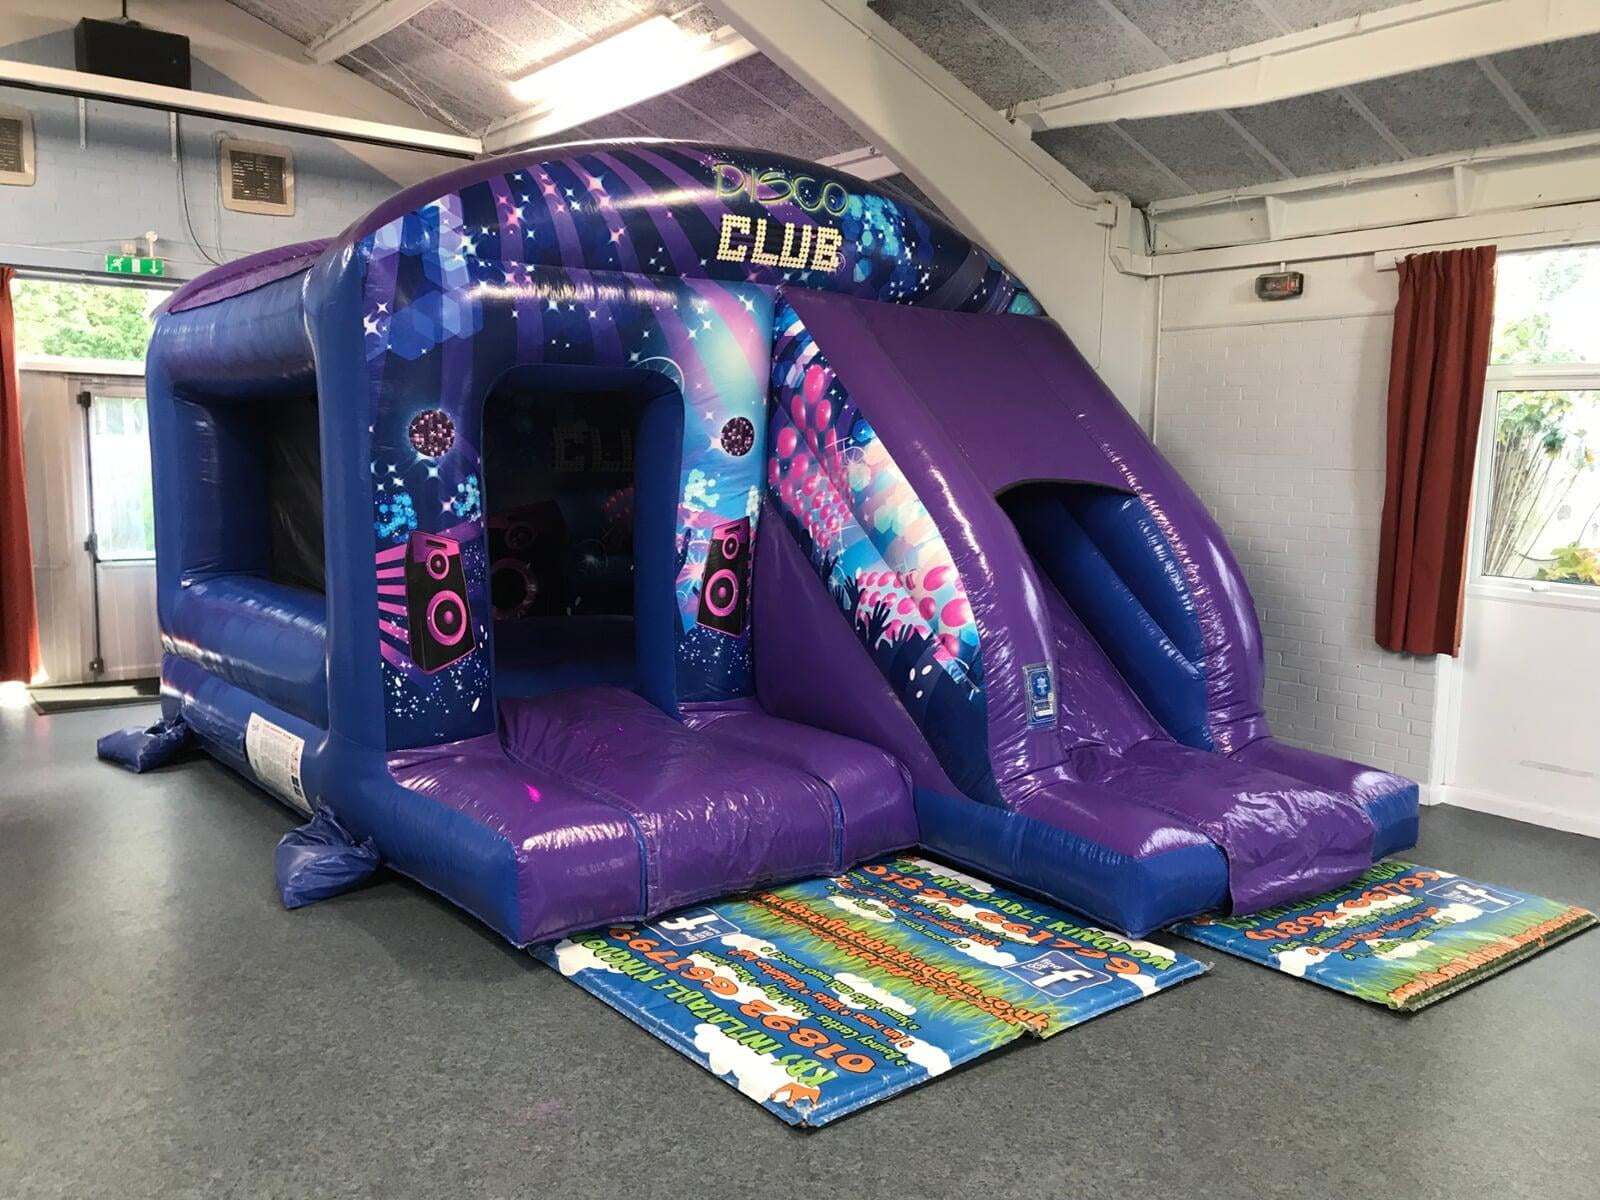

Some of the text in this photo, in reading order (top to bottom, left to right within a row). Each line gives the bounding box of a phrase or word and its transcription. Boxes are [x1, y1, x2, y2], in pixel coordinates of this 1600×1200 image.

[712, 162, 849, 216] DISCO
[716, 214, 842, 272] CLUB
[1343, 871, 1440, 908] 661799
[863, 863, 968, 907] 01892
[974, 911, 1142, 976] 661799
[1045, 920, 1176, 971] KINGDOM
[755, 960, 807, 990] Gladiator
[825, 979, 855, 995] and
[607, 927, 877, 1074] 01892 661799
[652, 976, 783, 1057] INFLATABLE
[811, 992, 847, 1011] Slides
[816, 1014, 860, 1039] Castles
[852, 1013, 885, 1030] runs
[857, 1035, 904, 1060] Bouncy
[769, 1053, 838, 1088] KBS
